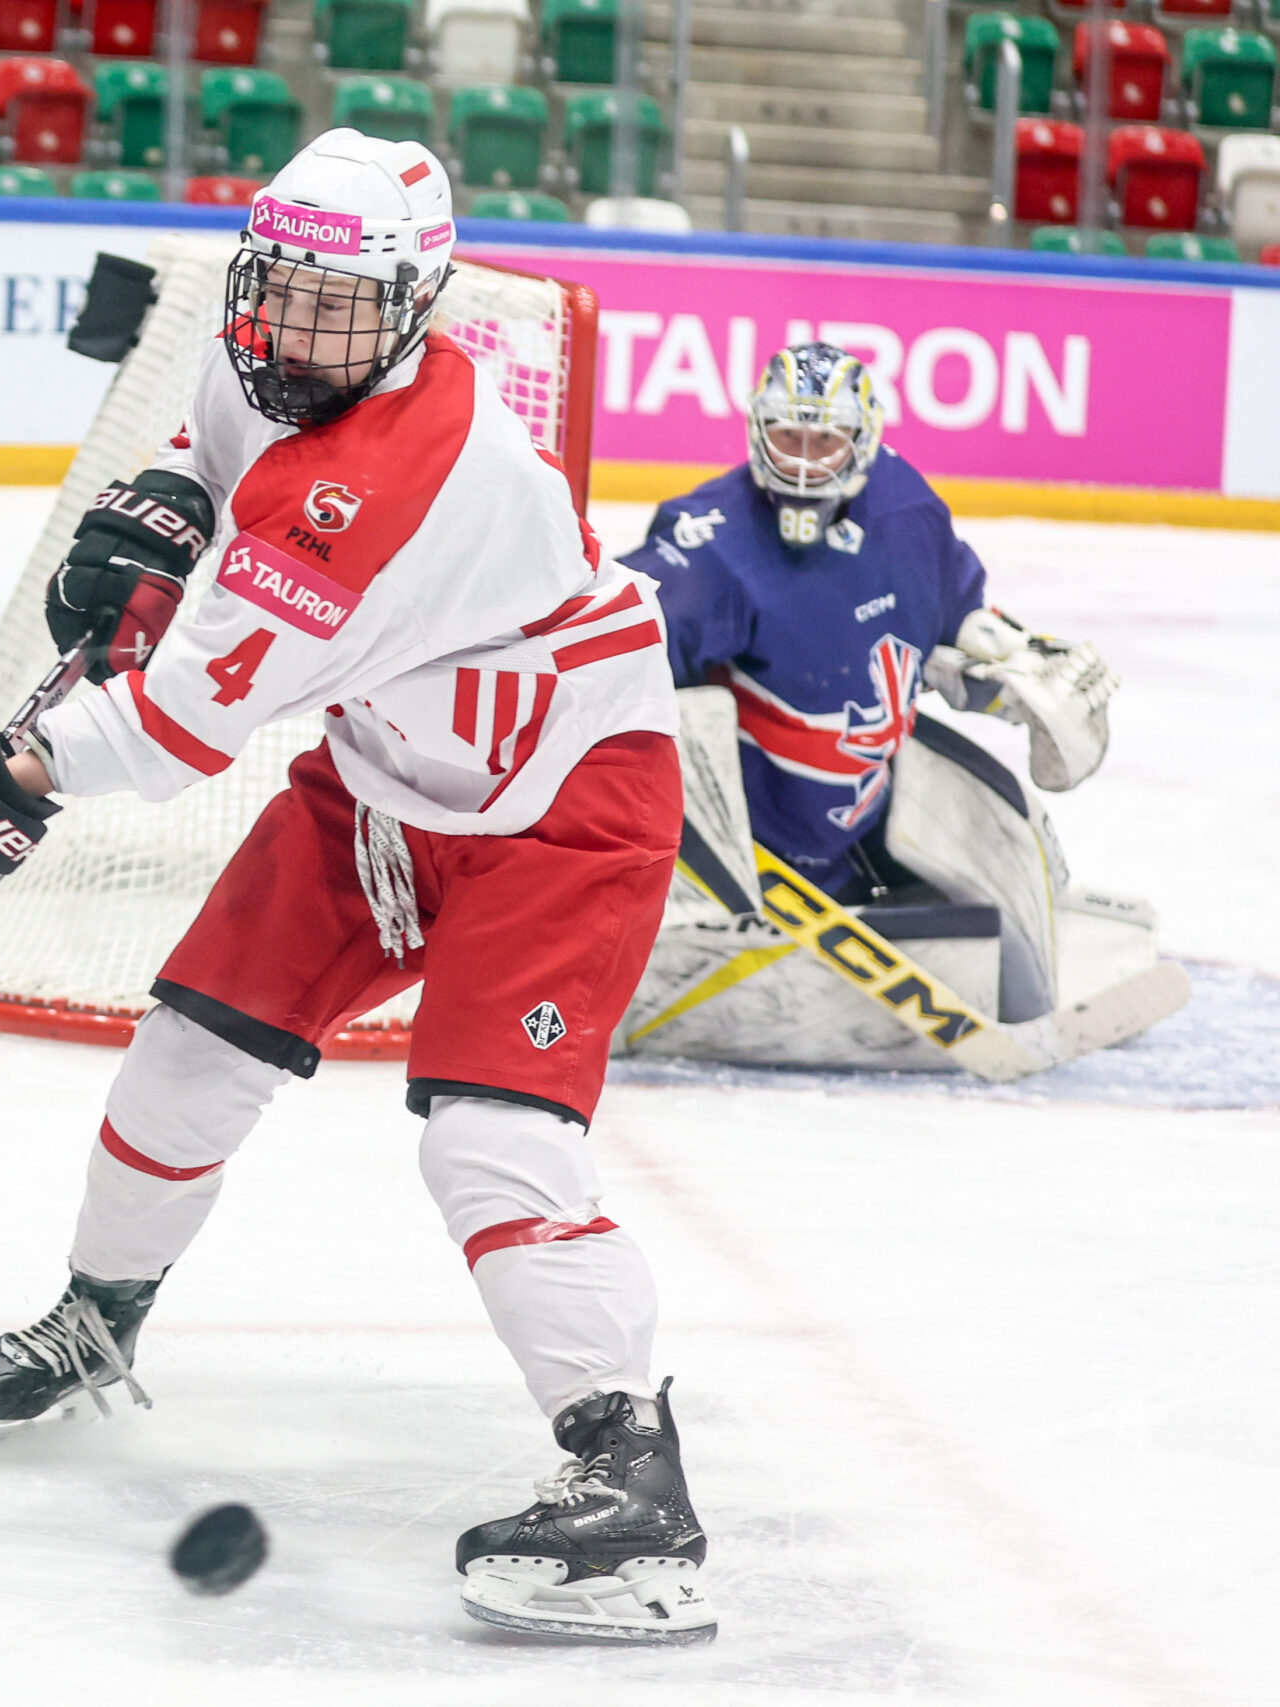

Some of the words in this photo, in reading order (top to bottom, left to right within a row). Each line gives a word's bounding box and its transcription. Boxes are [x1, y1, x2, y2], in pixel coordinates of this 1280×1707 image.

[272, 212, 352, 245] TAURON
[599, 310, 1091, 437] TAURON
[285, 525, 333, 563] PZHL
[778, 507, 819, 543] 86
[252, 561, 348, 628] TAURON
[854, 592, 897, 624] CCM
[206, 627, 278, 707] 4
[759, 870, 983, 1049] CCM
[536, 1004, 552, 1047] TACKLA
